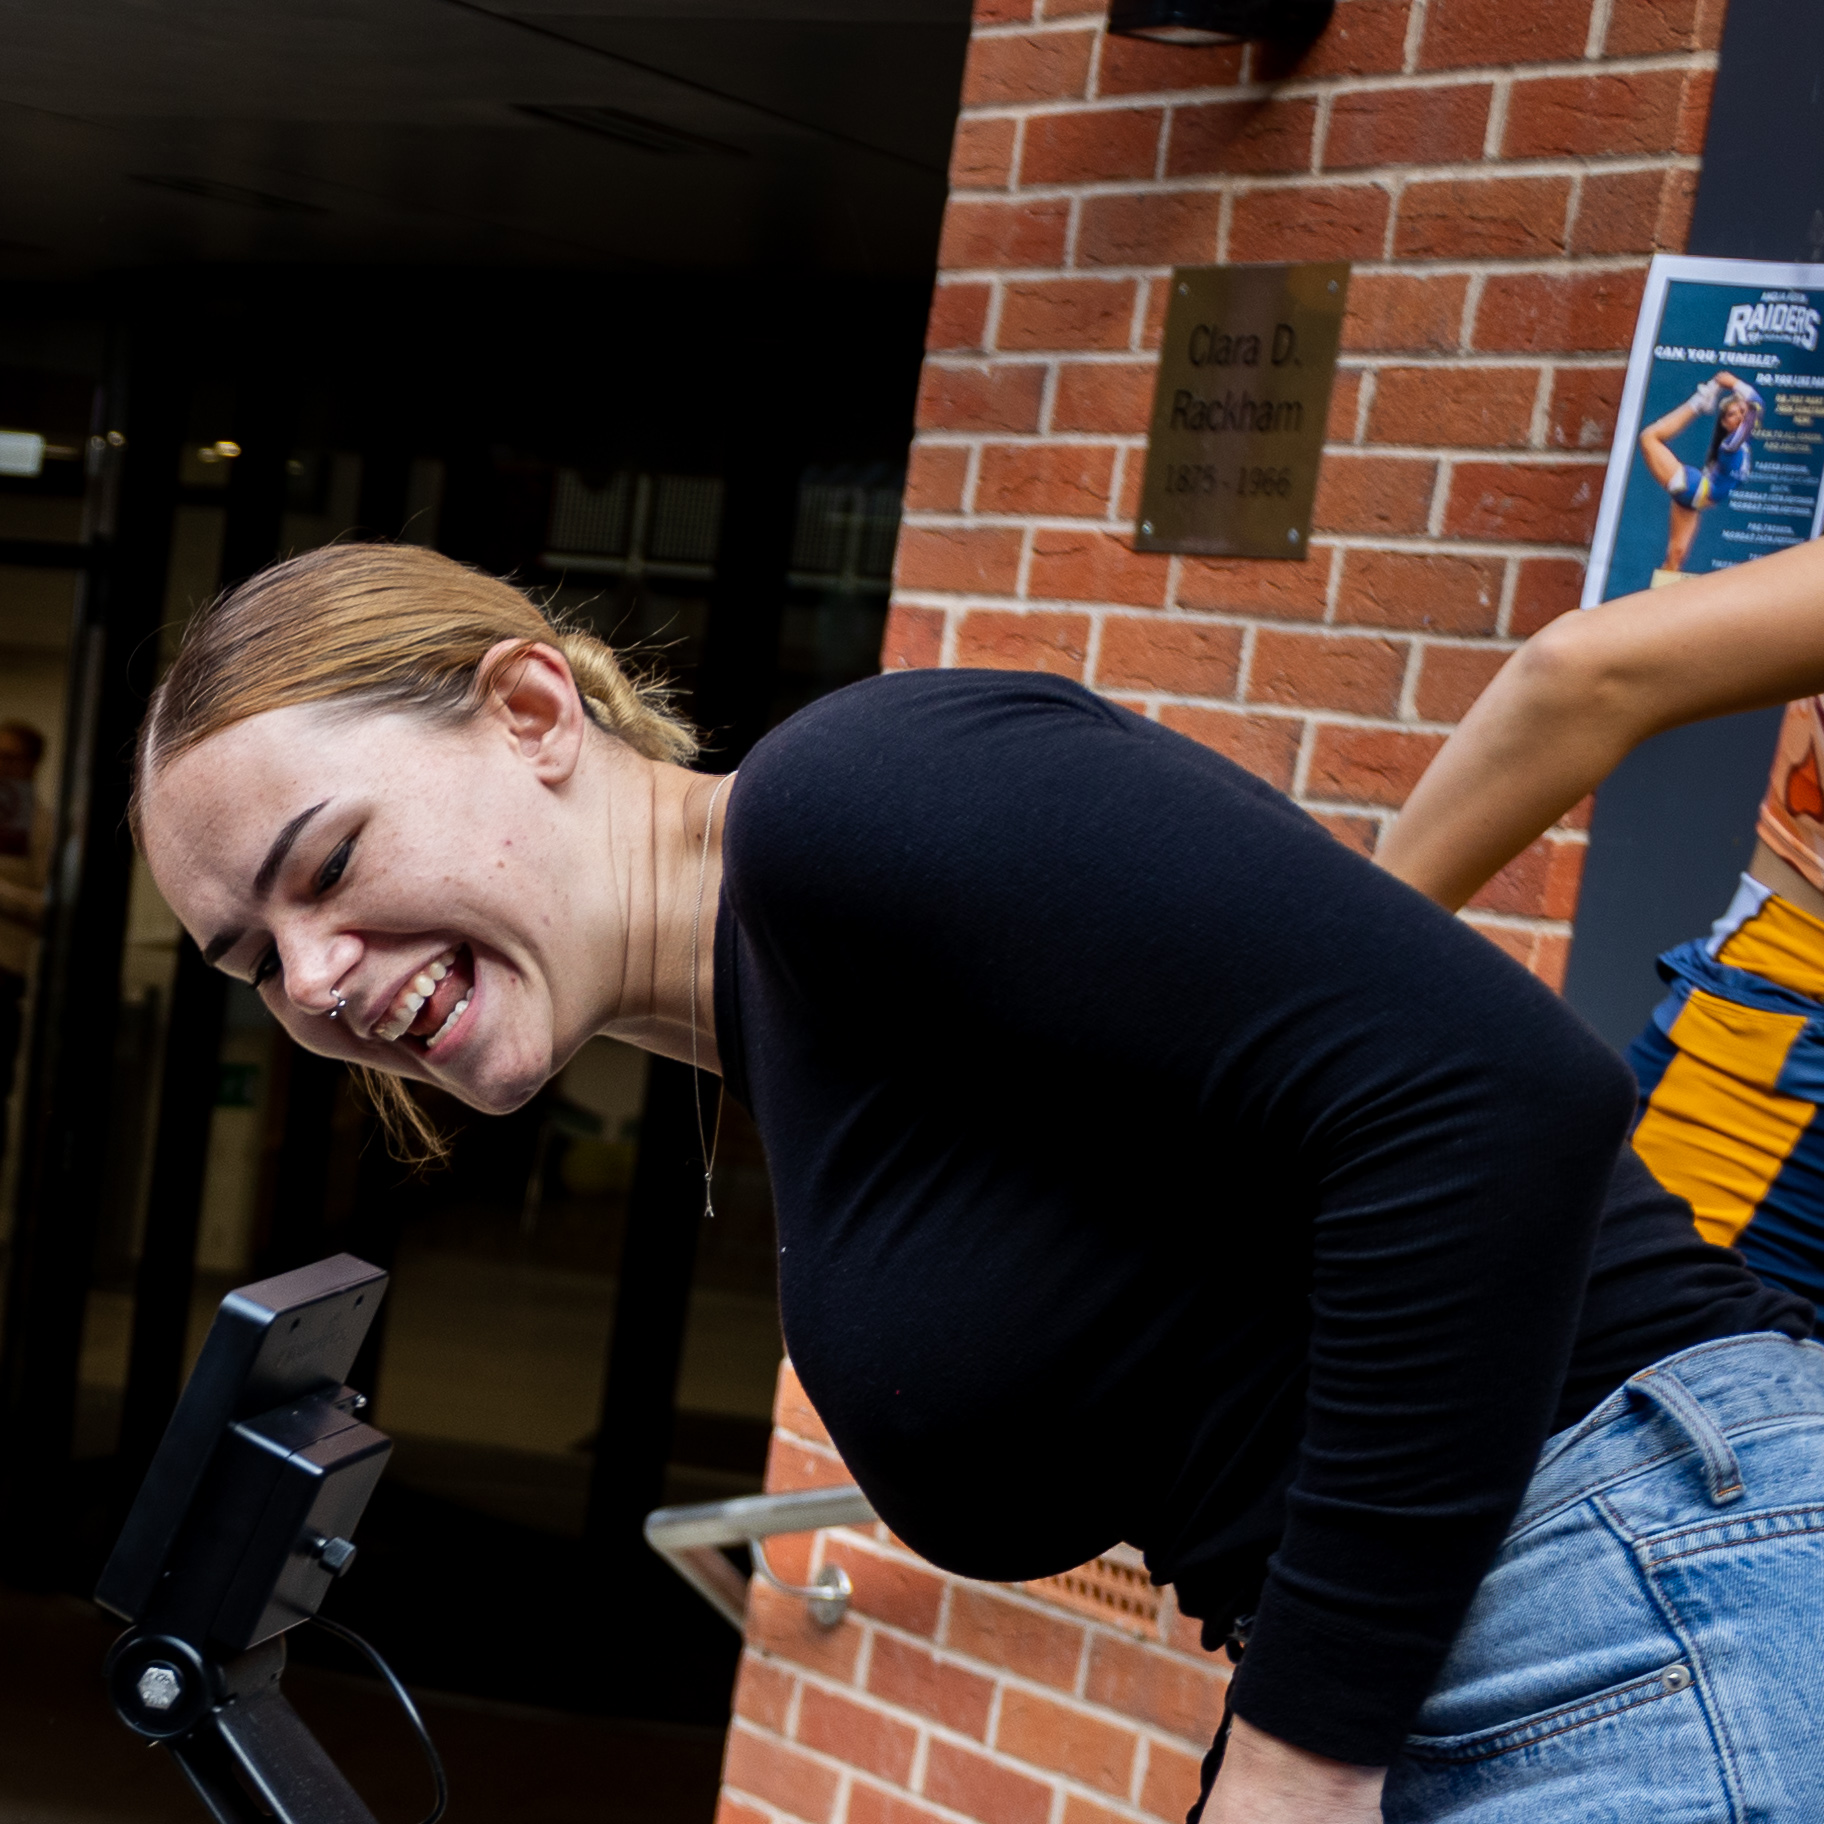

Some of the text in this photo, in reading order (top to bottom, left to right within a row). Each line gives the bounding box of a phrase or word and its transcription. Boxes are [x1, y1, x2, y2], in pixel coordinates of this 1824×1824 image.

[1189, 323, 1301, 367] Clara D.
[1723, 303, 1821, 351] RAIDERS
[1654, 345, 1781, 369] CAN YOU TUMBLE?
[1170, 389, 1304, 433] Rackham
[1165, 463, 1217, 494] 1875
